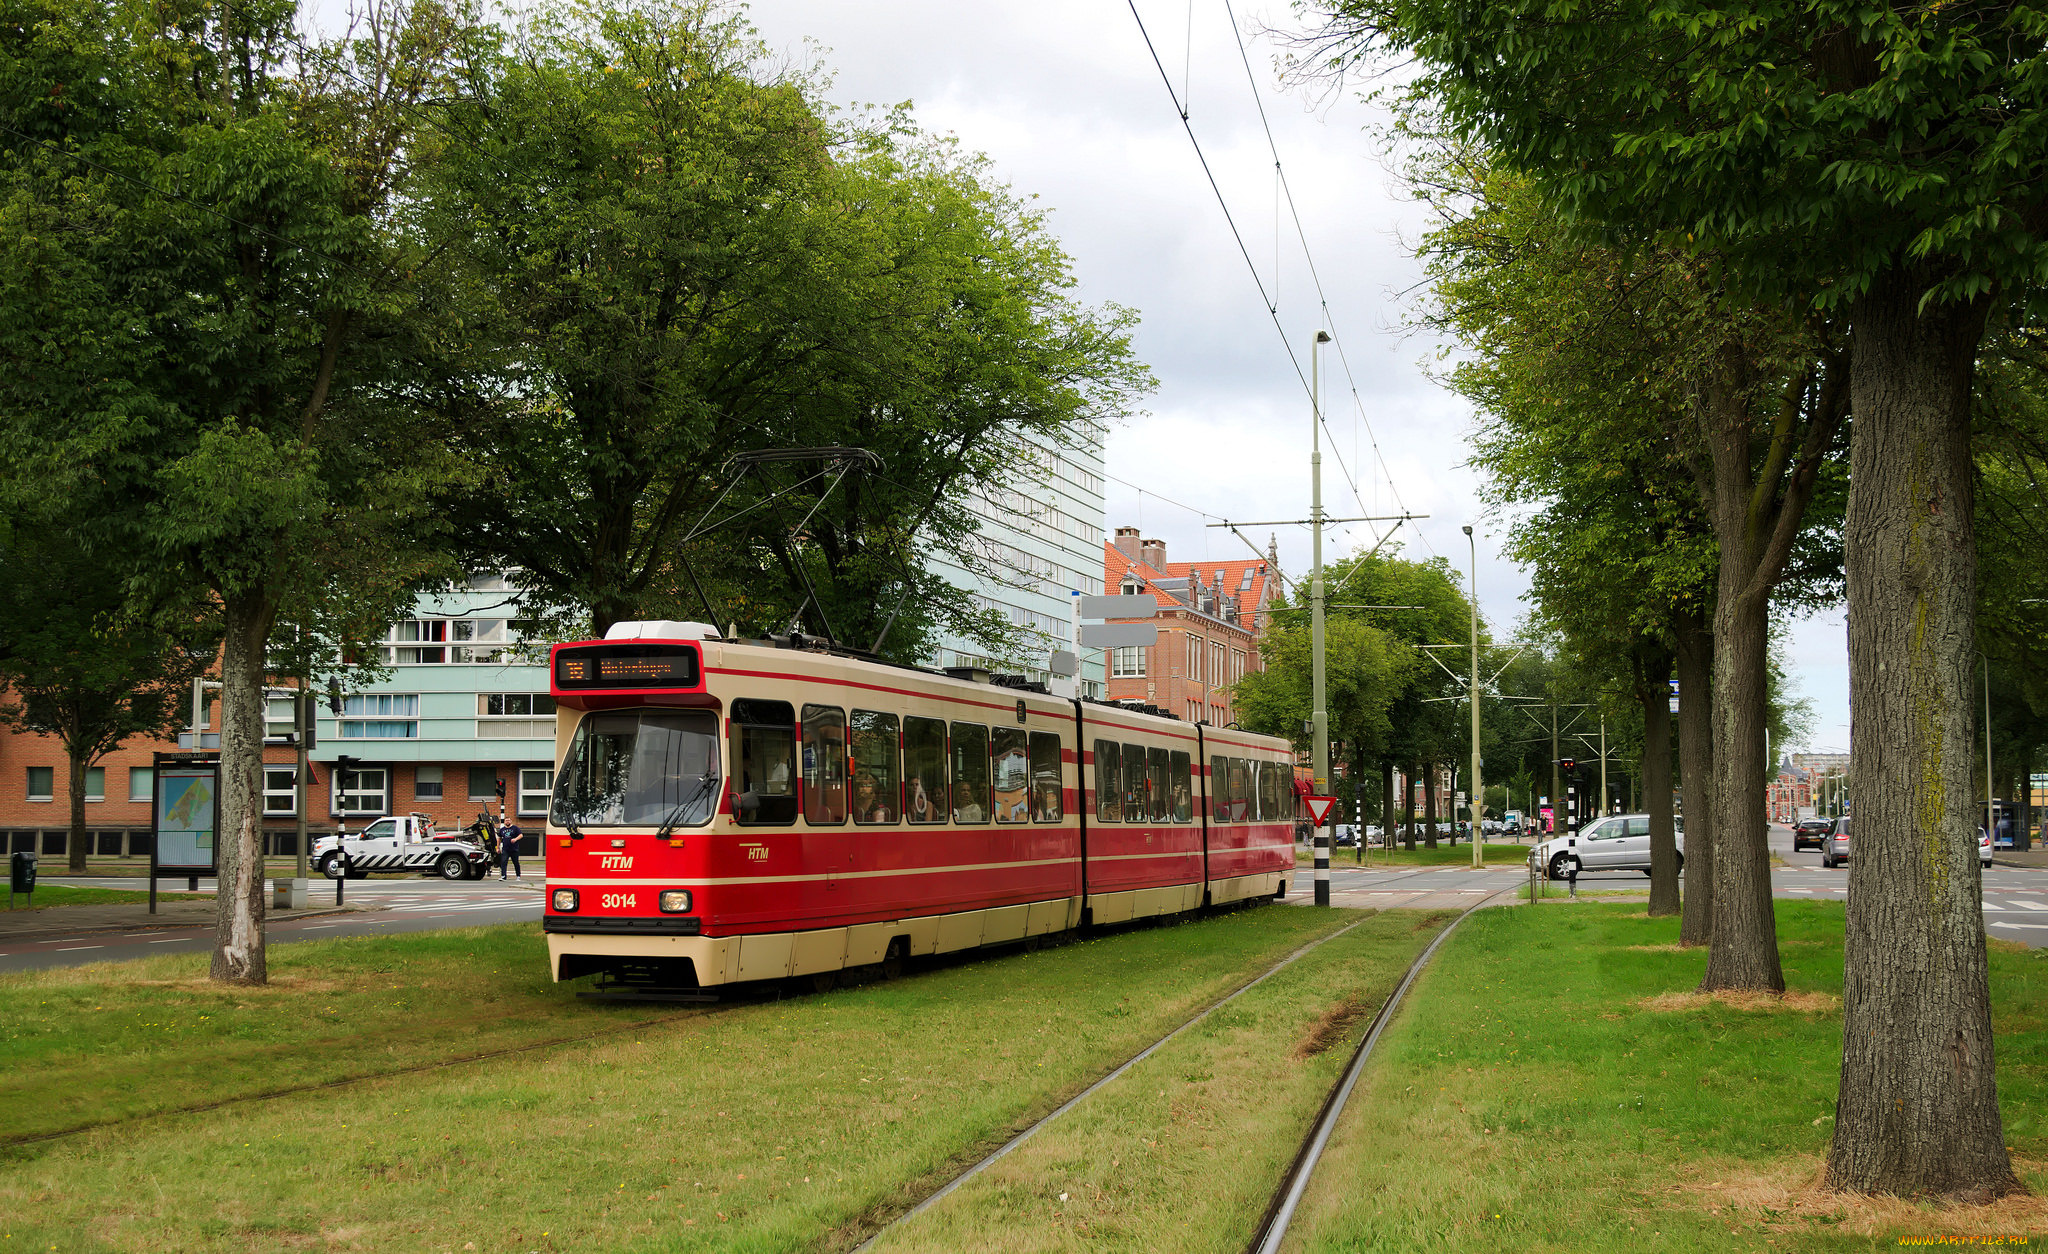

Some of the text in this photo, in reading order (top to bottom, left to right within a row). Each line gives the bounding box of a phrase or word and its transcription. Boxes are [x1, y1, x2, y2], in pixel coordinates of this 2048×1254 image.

[748, 847, 769, 860] HTM
[601, 856, 634, 869] HTM
[601, 893, 637, 908] 3014
